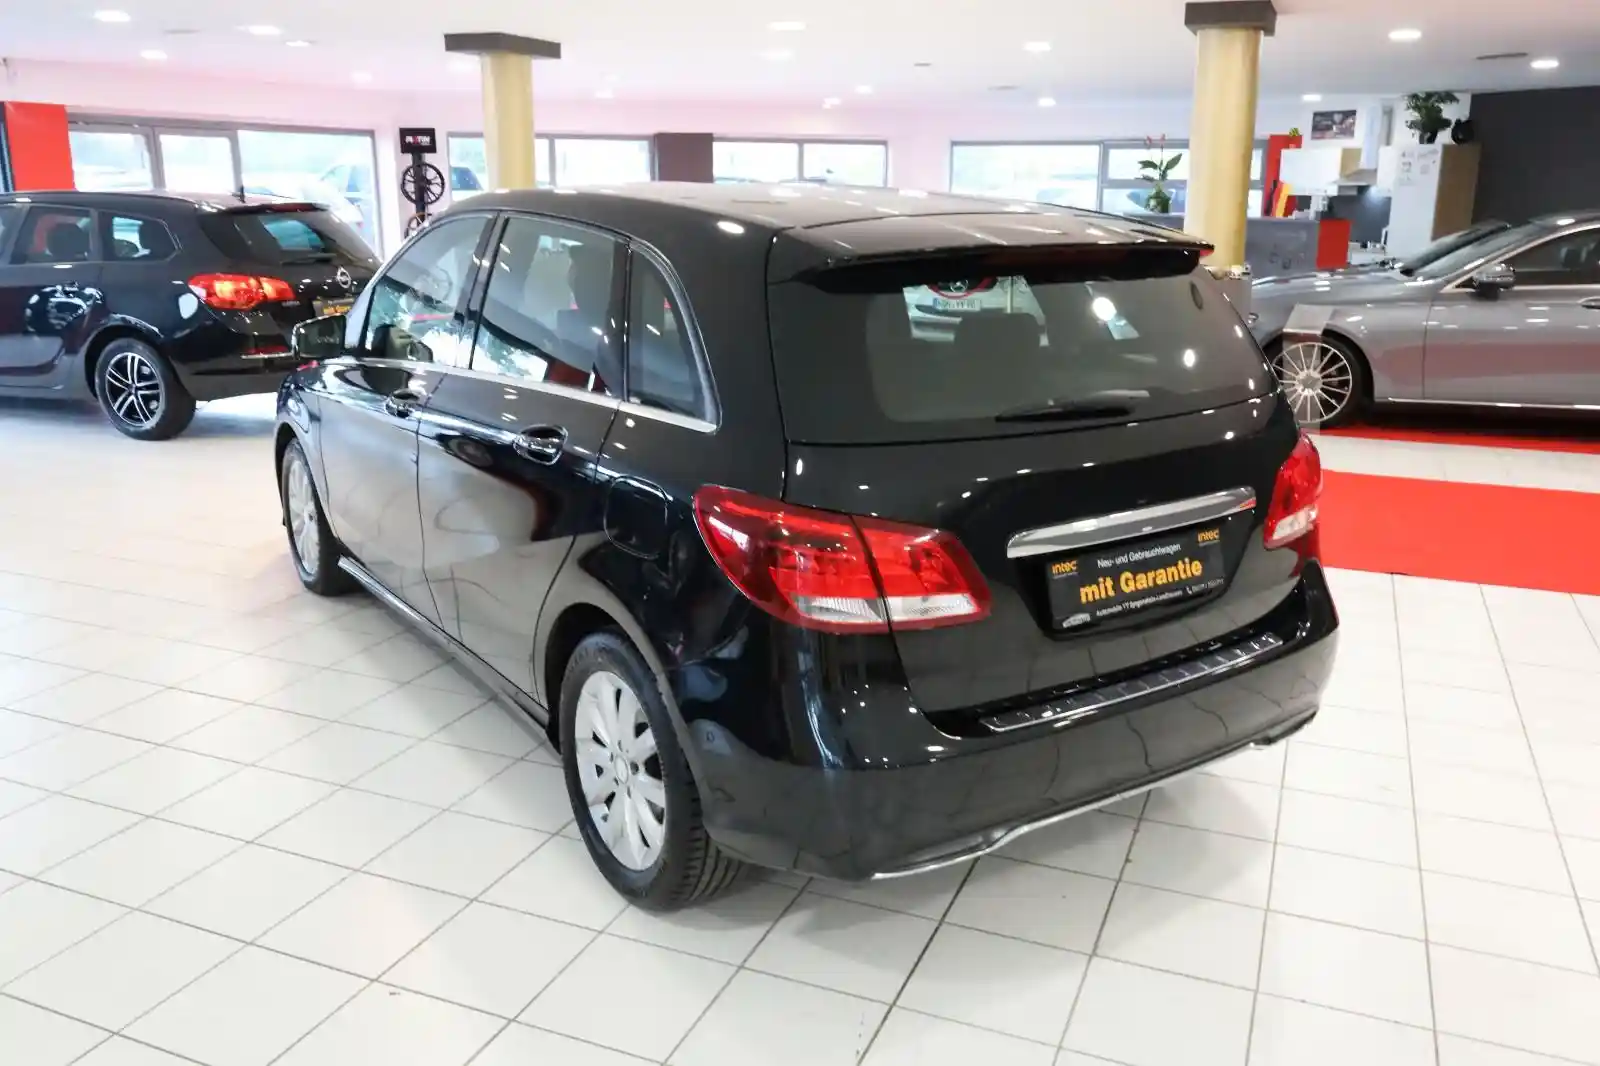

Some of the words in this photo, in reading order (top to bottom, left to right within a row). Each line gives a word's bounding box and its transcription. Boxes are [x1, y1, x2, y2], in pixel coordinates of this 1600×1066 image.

[1197, 528, 1220, 542] intec
[1097, 556, 1114, 569] Neu-
[1114, 553, 1129, 566] und
[1128, 543, 1182, 563] Gebrauchtwagen
[1051, 560, 1078, 574] intec
[1079, 576, 1116, 604] mit
[1119, 558, 1203, 594] Garantie
